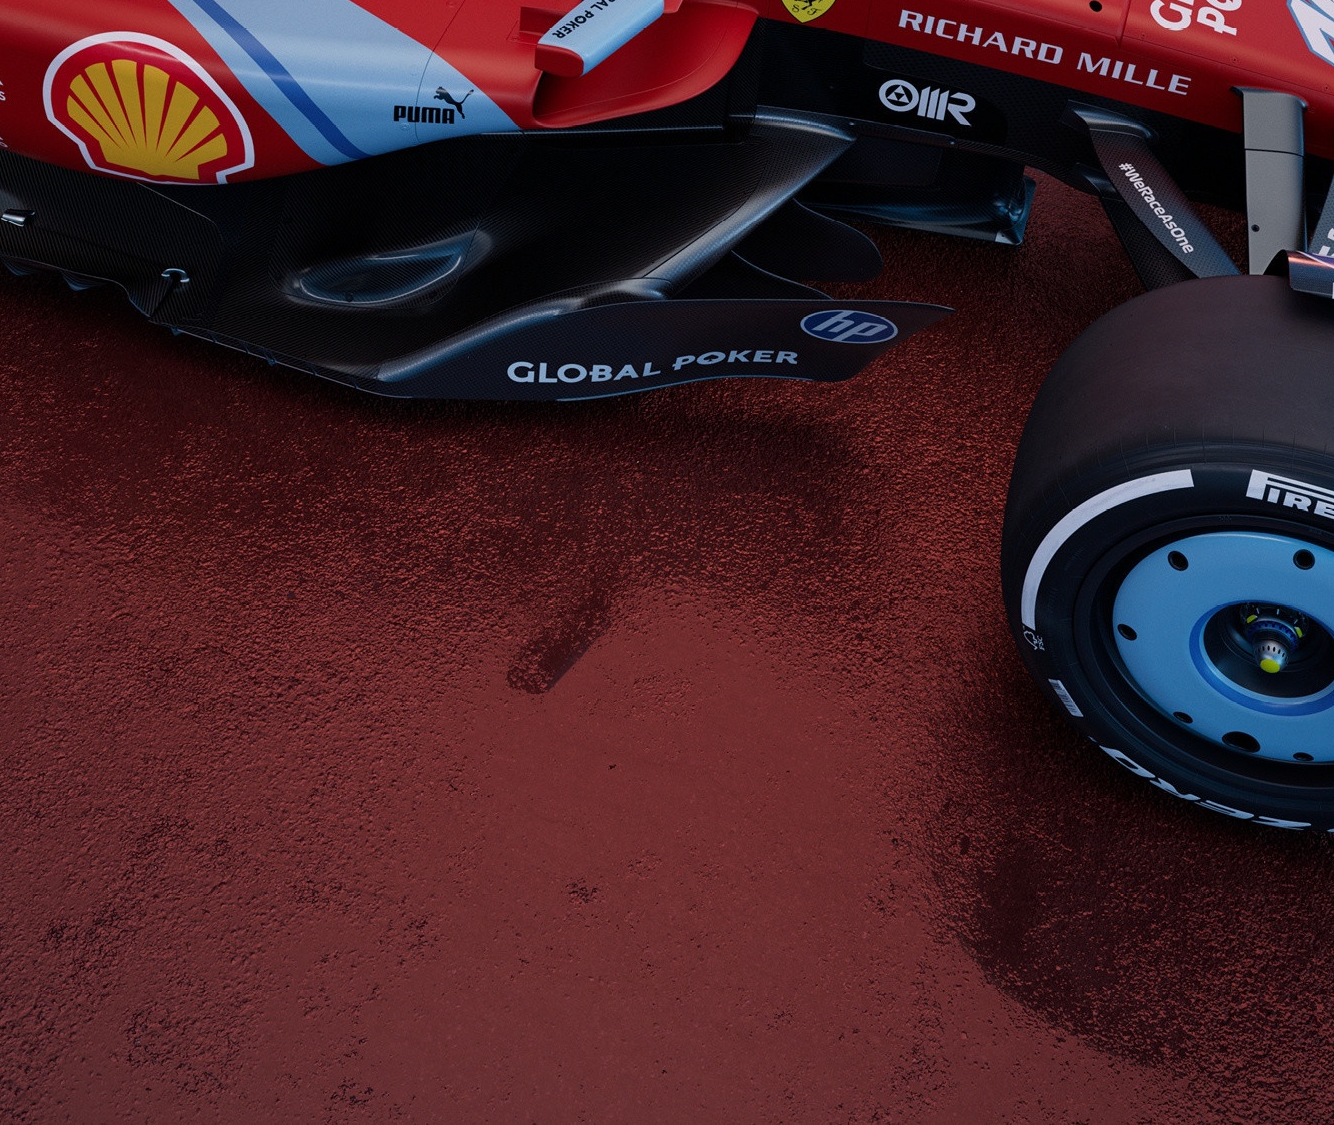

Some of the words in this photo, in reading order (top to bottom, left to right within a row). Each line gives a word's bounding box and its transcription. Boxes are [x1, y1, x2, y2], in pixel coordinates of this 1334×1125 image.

[552, 8, 595, 40] POKER
[898, 9, 1063, 65] RICHARD
[1077, 52, 1192, 96] MILLE
[394, 104, 455, 125] PUMA
[1119, 162, 1194, 254] #WeRaceAsOne
[810, 310, 892, 343] hp
[507, 361, 662, 384] GLOBAL
[672, 350, 799, 371] POKER
